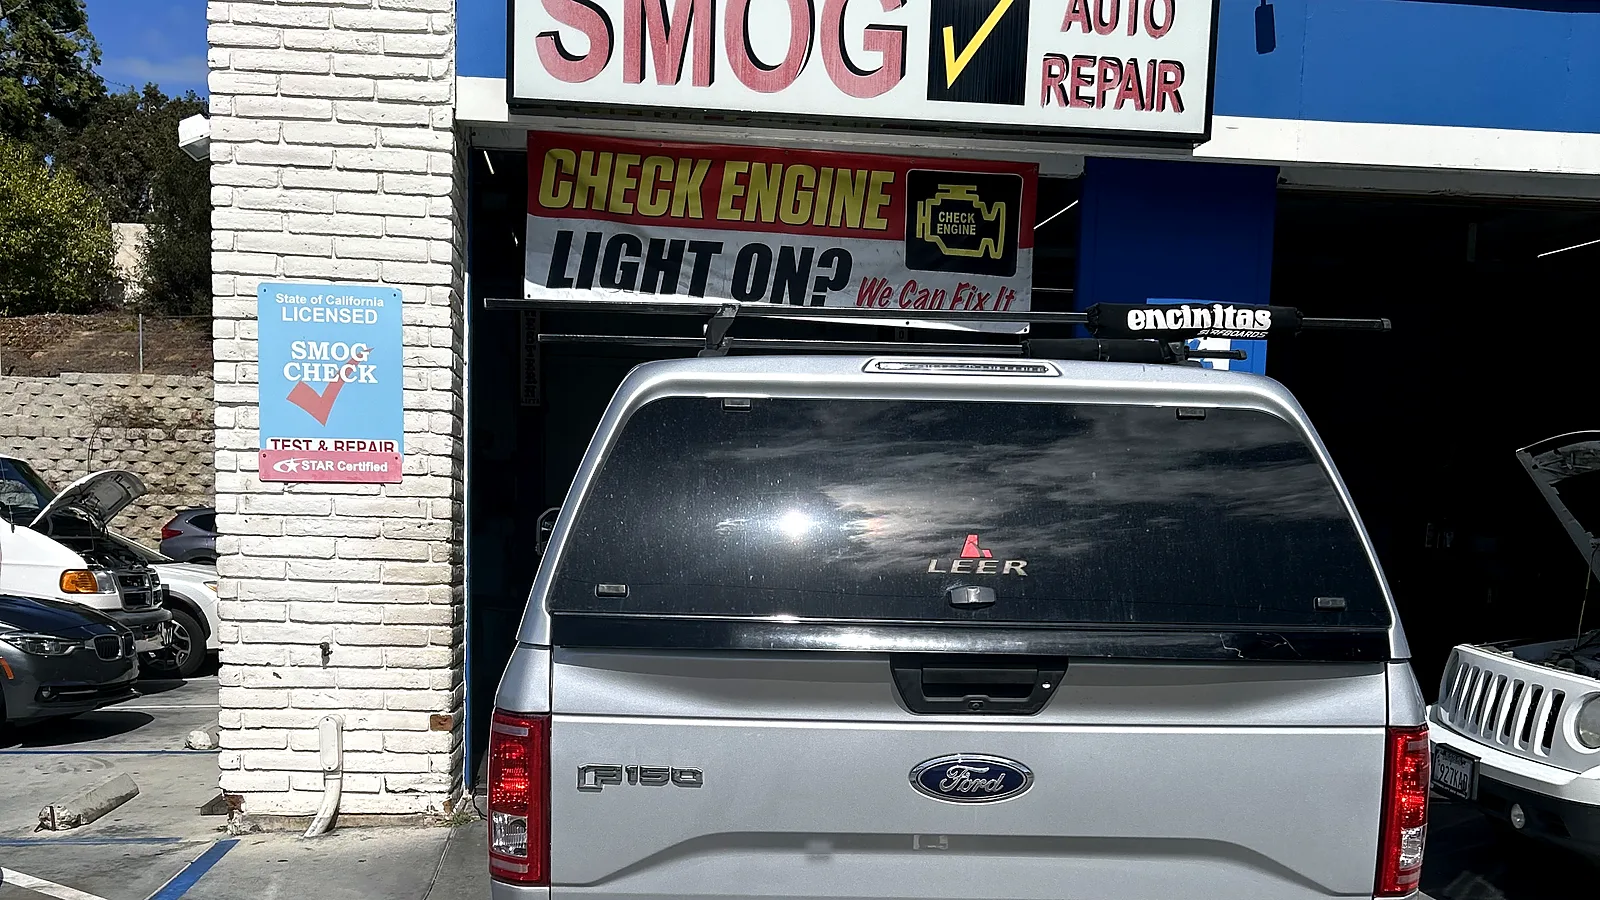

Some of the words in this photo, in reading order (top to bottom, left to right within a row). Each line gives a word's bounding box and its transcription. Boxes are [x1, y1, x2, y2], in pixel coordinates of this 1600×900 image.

[1060, 0, 1176, 39] AUTO
[535, 0, 906, 99] SMOG
[1040, 53, 1186, 114] REPAIR
[538, 147, 713, 219] CHECK
[716, 159, 896, 230] ENGINE
[937, 223, 976, 235] ENGINE
[938, 211, 975, 223] CHECK
[546, 230, 724, 298] LIGHT
[730, 242, 853, 307] ON?
[275, 293, 307, 305] State
[310, 294, 323, 305] of
[325, 295, 384, 307] California
[856, 276, 894, 308] We
[898, 279, 947, 310] Can
[950, 282, 991, 311] Fix
[992, 286, 1016, 311] It
[281, 306, 378, 324] LICENSED
[1127, 303, 1272, 331] encinitas
[291, 340, 370, 361] SMOG
[283, 362, 378, 384] CHECK
[270, 439, 312, 450] TEST
[334, 440, 395, 453] REPAIR
[301, 460, 335, 471] STAR
[337, 461, 388, 472] Certified
[927, 559, 1028, 577] LEER
[577, 763, 703, 793] F150
[939, 765, 1006, 793] Ford
